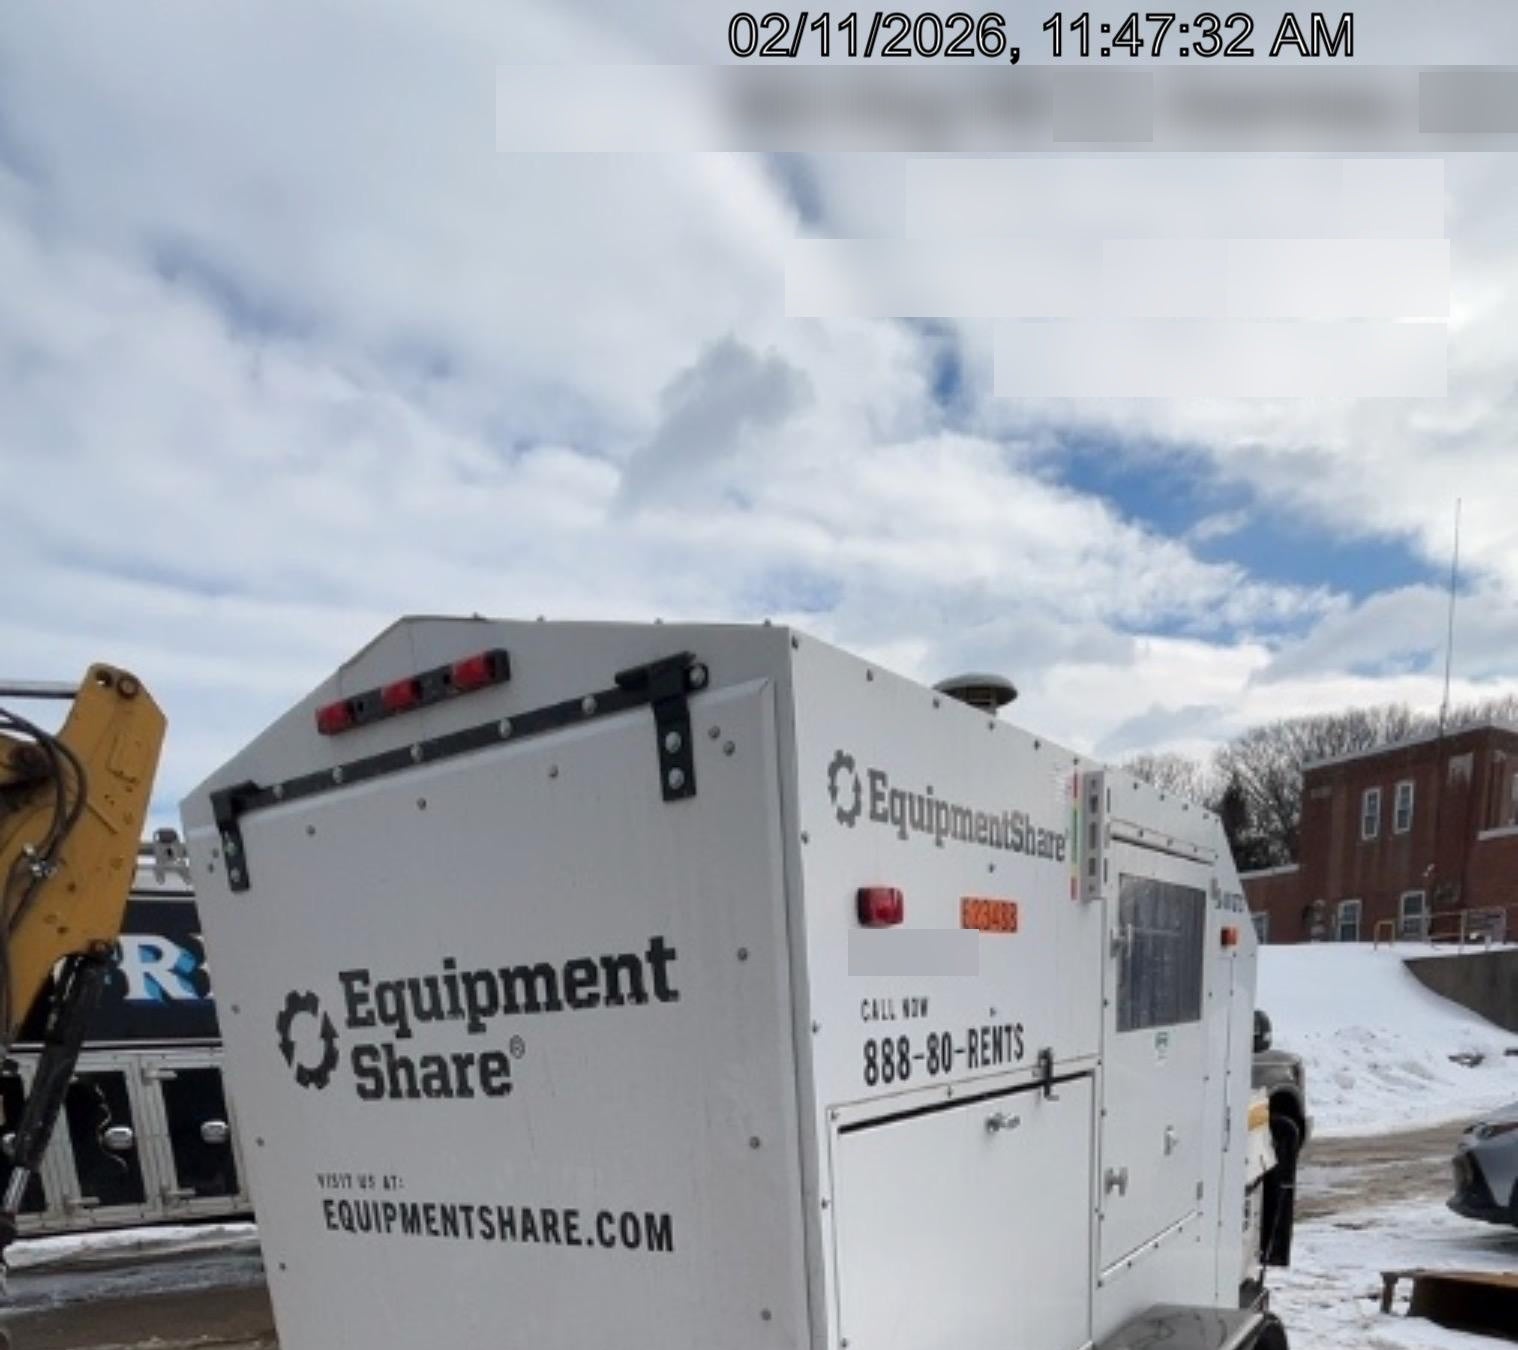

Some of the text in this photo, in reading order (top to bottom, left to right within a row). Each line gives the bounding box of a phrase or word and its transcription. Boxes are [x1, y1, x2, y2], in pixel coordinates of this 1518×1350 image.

[338, 935, 680, 1039] Equipment
[861, 995, 929, 1022] CALL NOW
[863, 1022, 1025, 1087] 888-80-RENTS
[316, 1173, 352, 1190] VISIT
[358, 1174, 376, 1190] US
[322, 1199, 675, 1252] EQUIPMENTSHARE.COM
